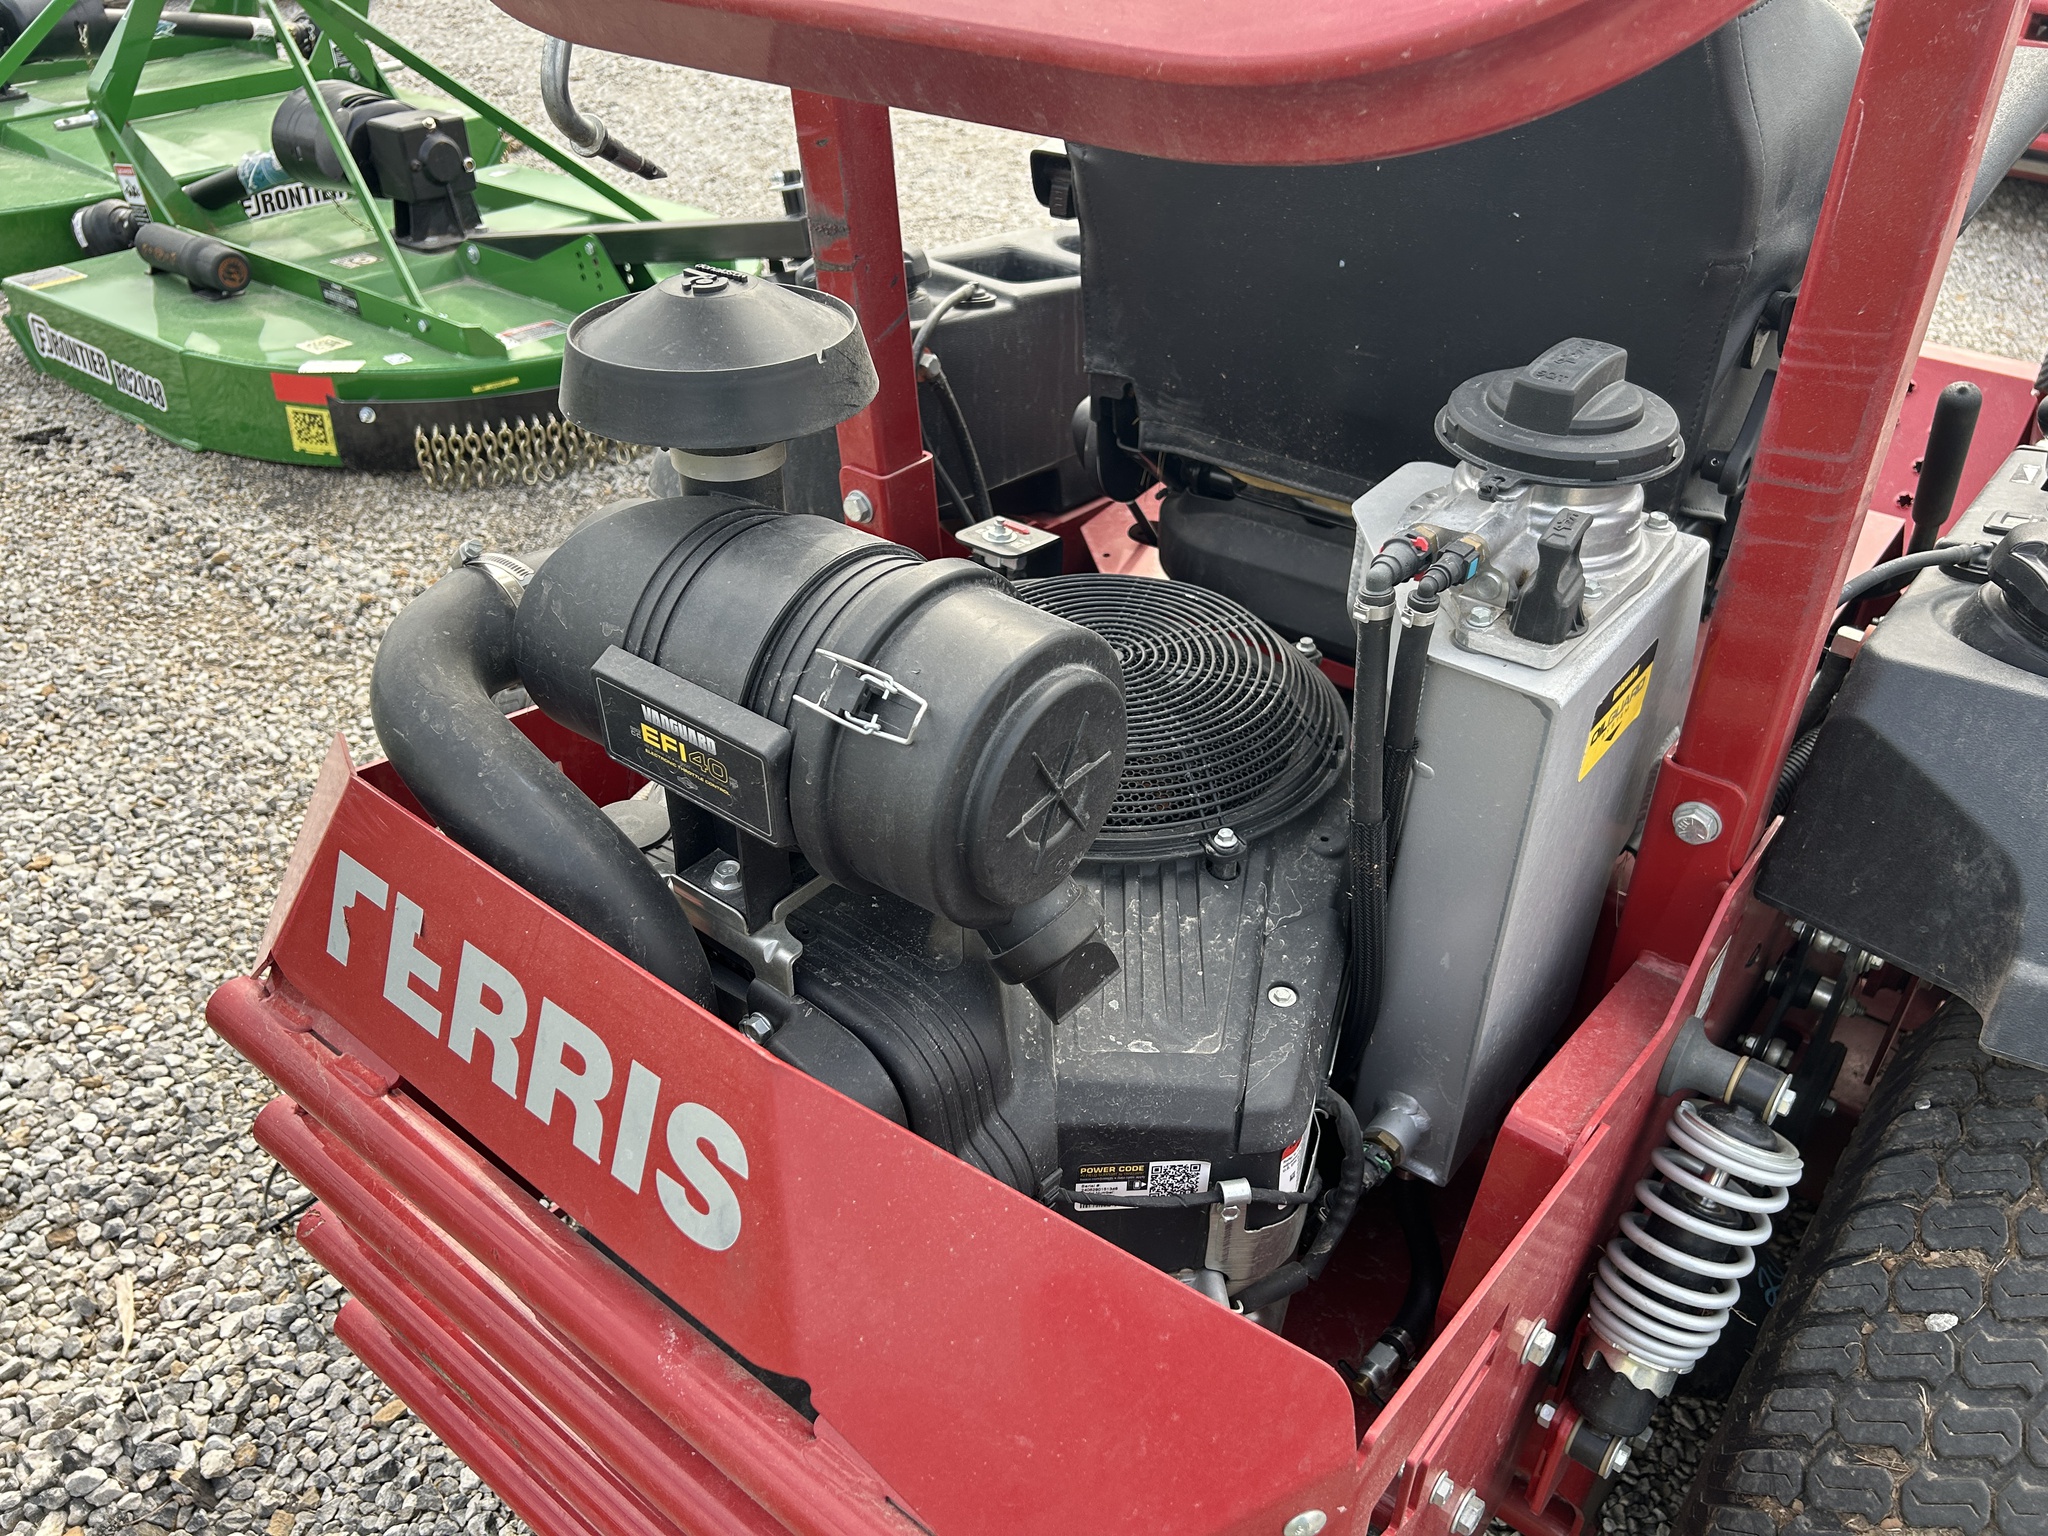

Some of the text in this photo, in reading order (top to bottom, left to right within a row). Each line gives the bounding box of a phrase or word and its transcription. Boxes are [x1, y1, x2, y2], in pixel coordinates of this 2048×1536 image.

[29, 314, 167, 411] FRONTIER RC2048
[641, 704, 717, 755] VANGUARD
[645, 748, 677, 768] ELECTRONIC
[678, 765, 704, 782] THROTTLE
[326, 849, 750, 1251] FERRIS
[1080, 1166, 1116, 1175] POWER
[1118, 1165, 1145, 1173] CODE
